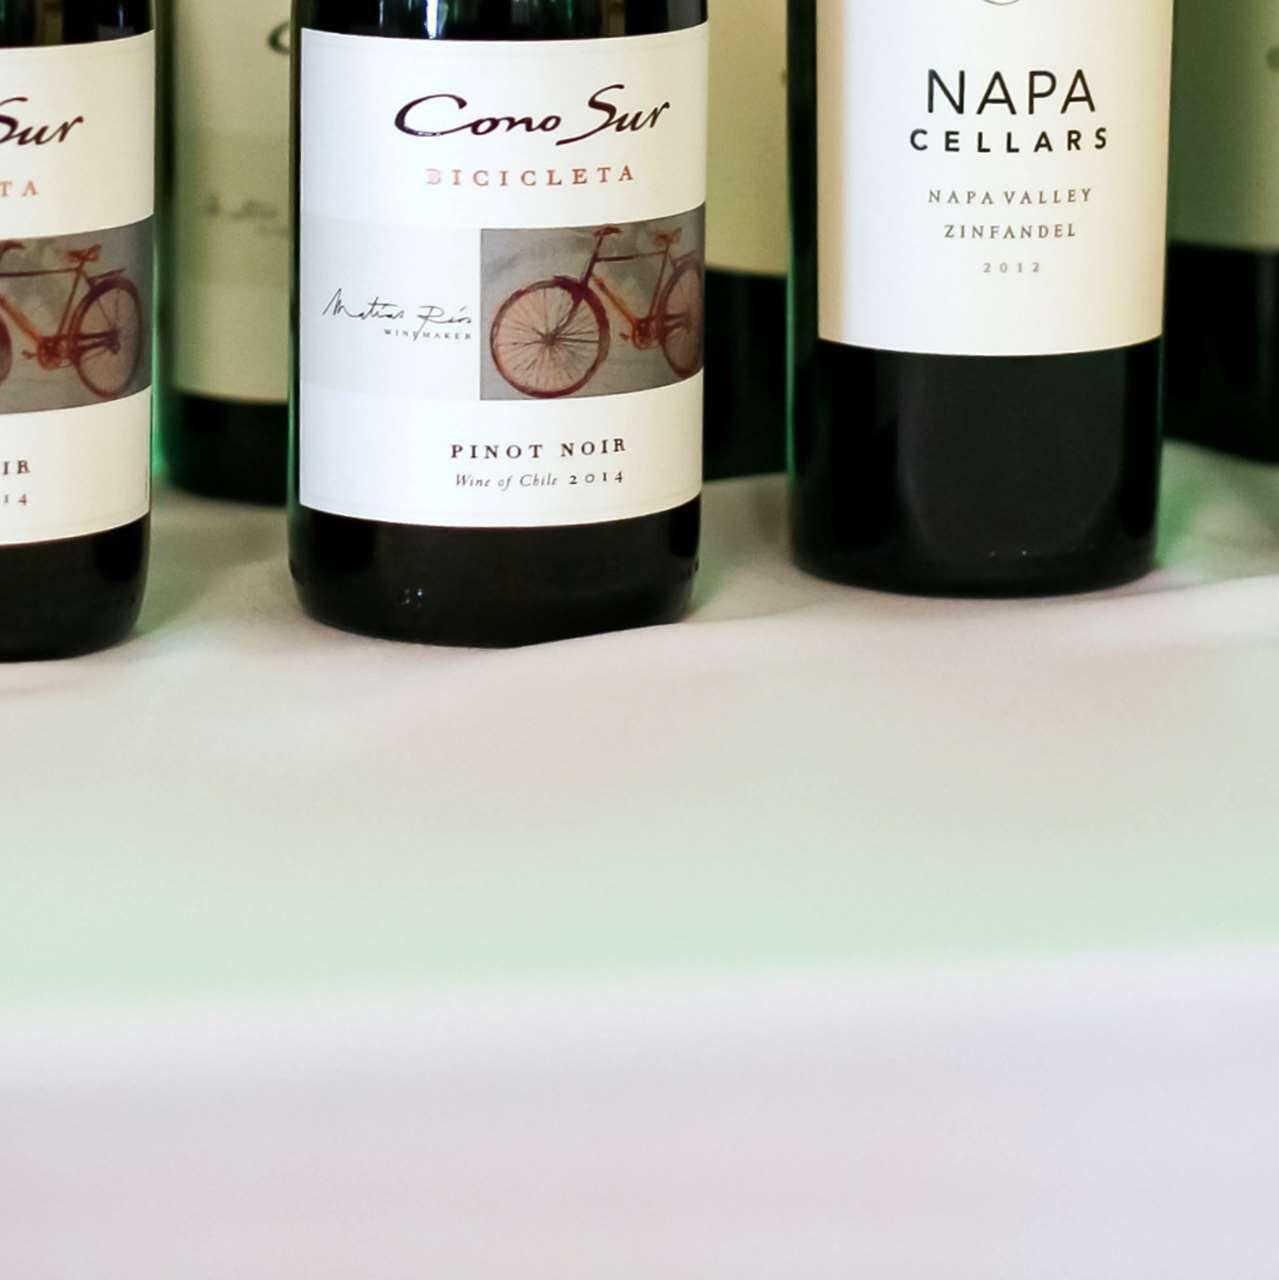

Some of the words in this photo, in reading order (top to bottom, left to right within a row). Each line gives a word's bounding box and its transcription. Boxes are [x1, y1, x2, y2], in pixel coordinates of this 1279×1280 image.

[926, 68, 1097, 116] NAPA
[394, 93, 561, 136] Cono
[555, 84, 670, 146] Sur
[909, 126, 1107, 154] CELLARS
[425, 165, 634, 186] BICICLETA
[928, 189, 995, 206] NAPA
[1003, 187, 1093, 205] VALLEY
[943, 223, 1077, 239] ZINFANDEL
[982, 262, 1041, 274] 2012
[450, 444, 543, 459] PINOT
[560, 438, 625, 457] NOIR
[456, 474, 490, 487] Wine
[498, 475, 512, 491] of
[520, 473, 558, 487] Chile
[569, 471, 623, 485] 2014
